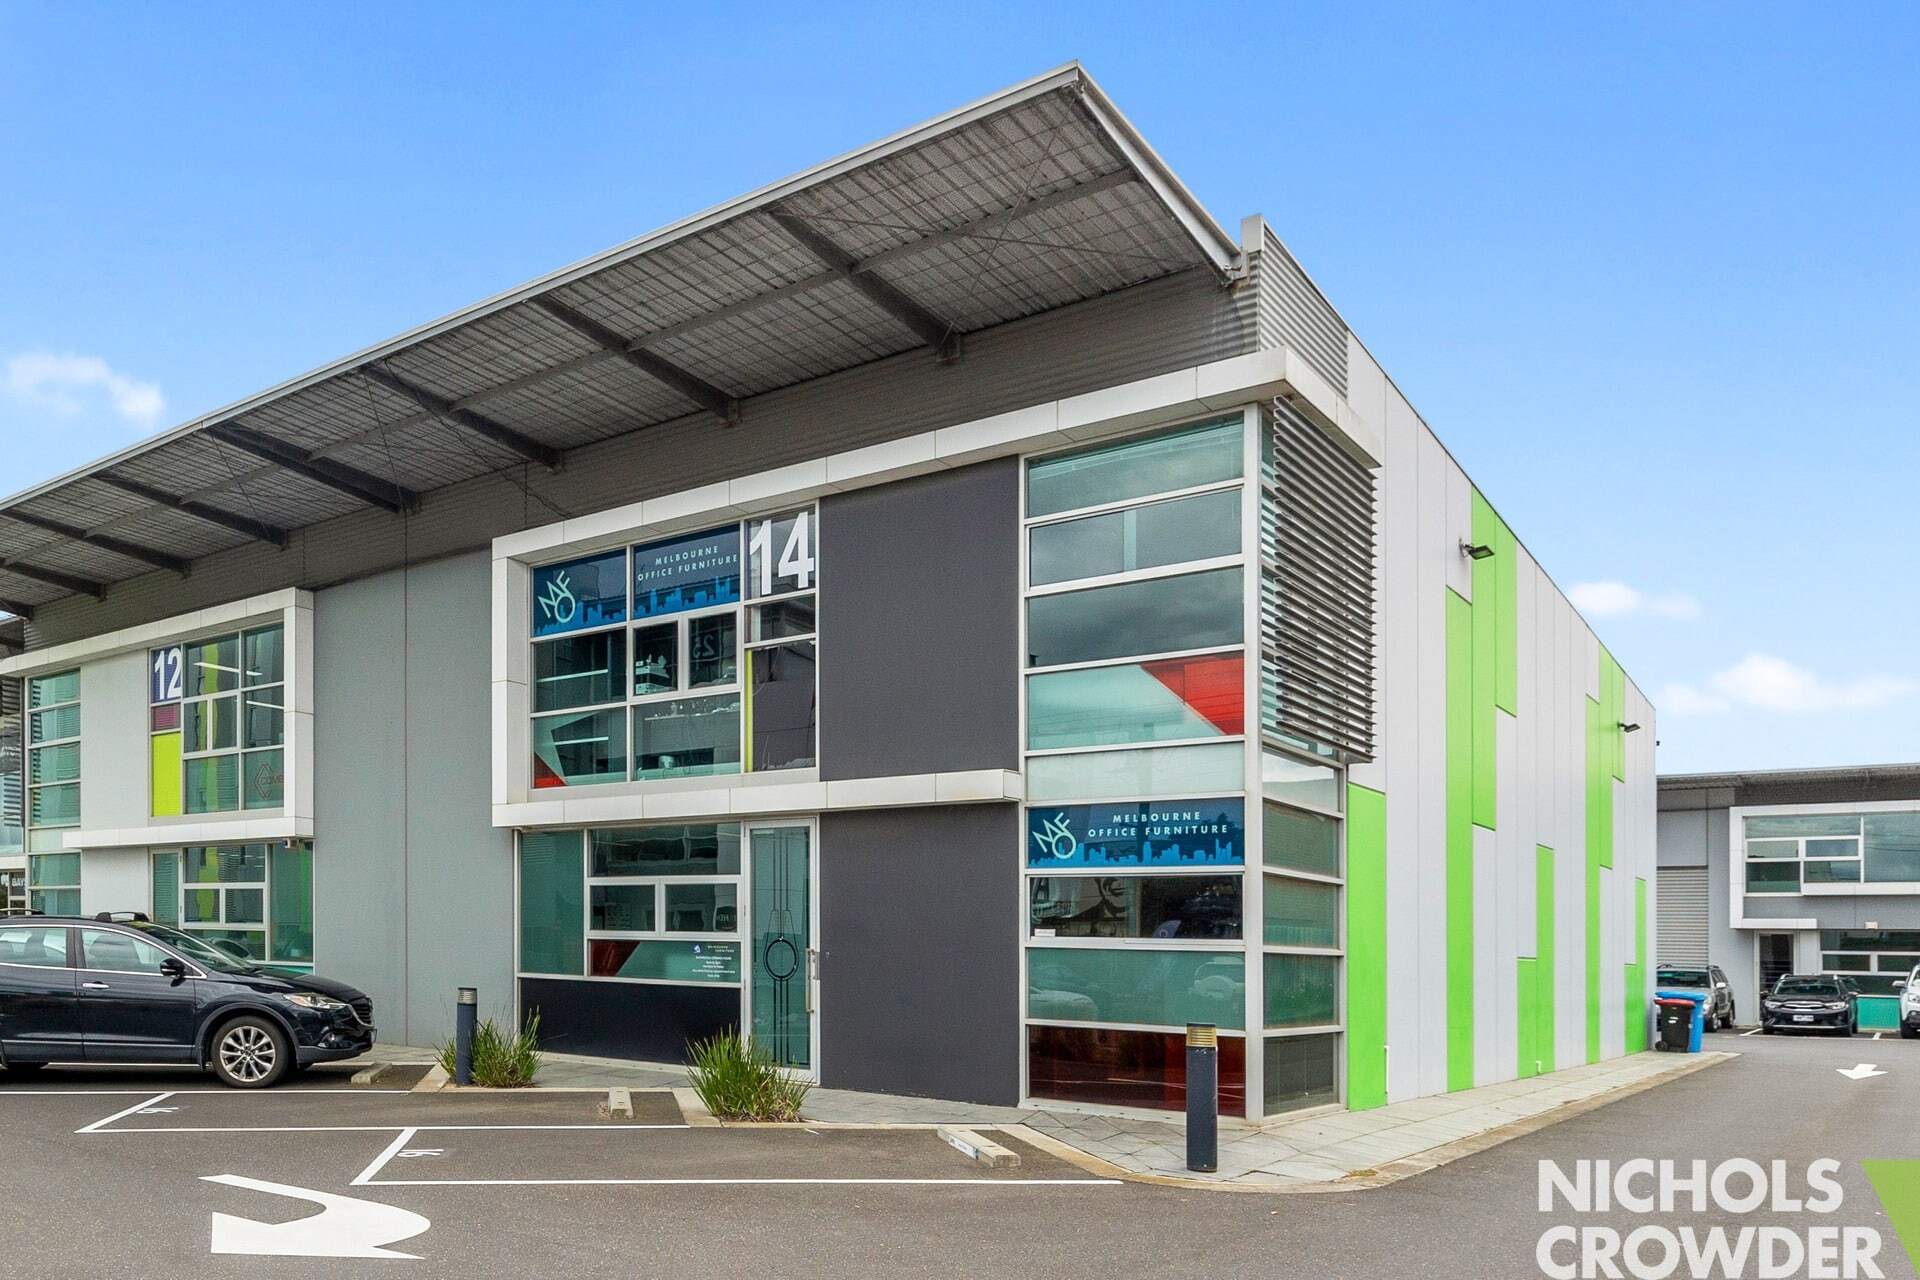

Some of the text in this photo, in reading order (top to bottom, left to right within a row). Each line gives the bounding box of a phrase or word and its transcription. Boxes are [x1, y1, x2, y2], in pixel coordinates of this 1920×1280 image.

[655, 545, 719, 566] MELBOURNE
[749, 511, 815, 596] 14
[637, 553, 738, 582] OFFICE FURNITURE
[154, 647, 182, 700] 12
[1112, 811, 1201, 824] MELBOURNE
[1088, 824, 1228, 838] OFFICE FURNITURE
